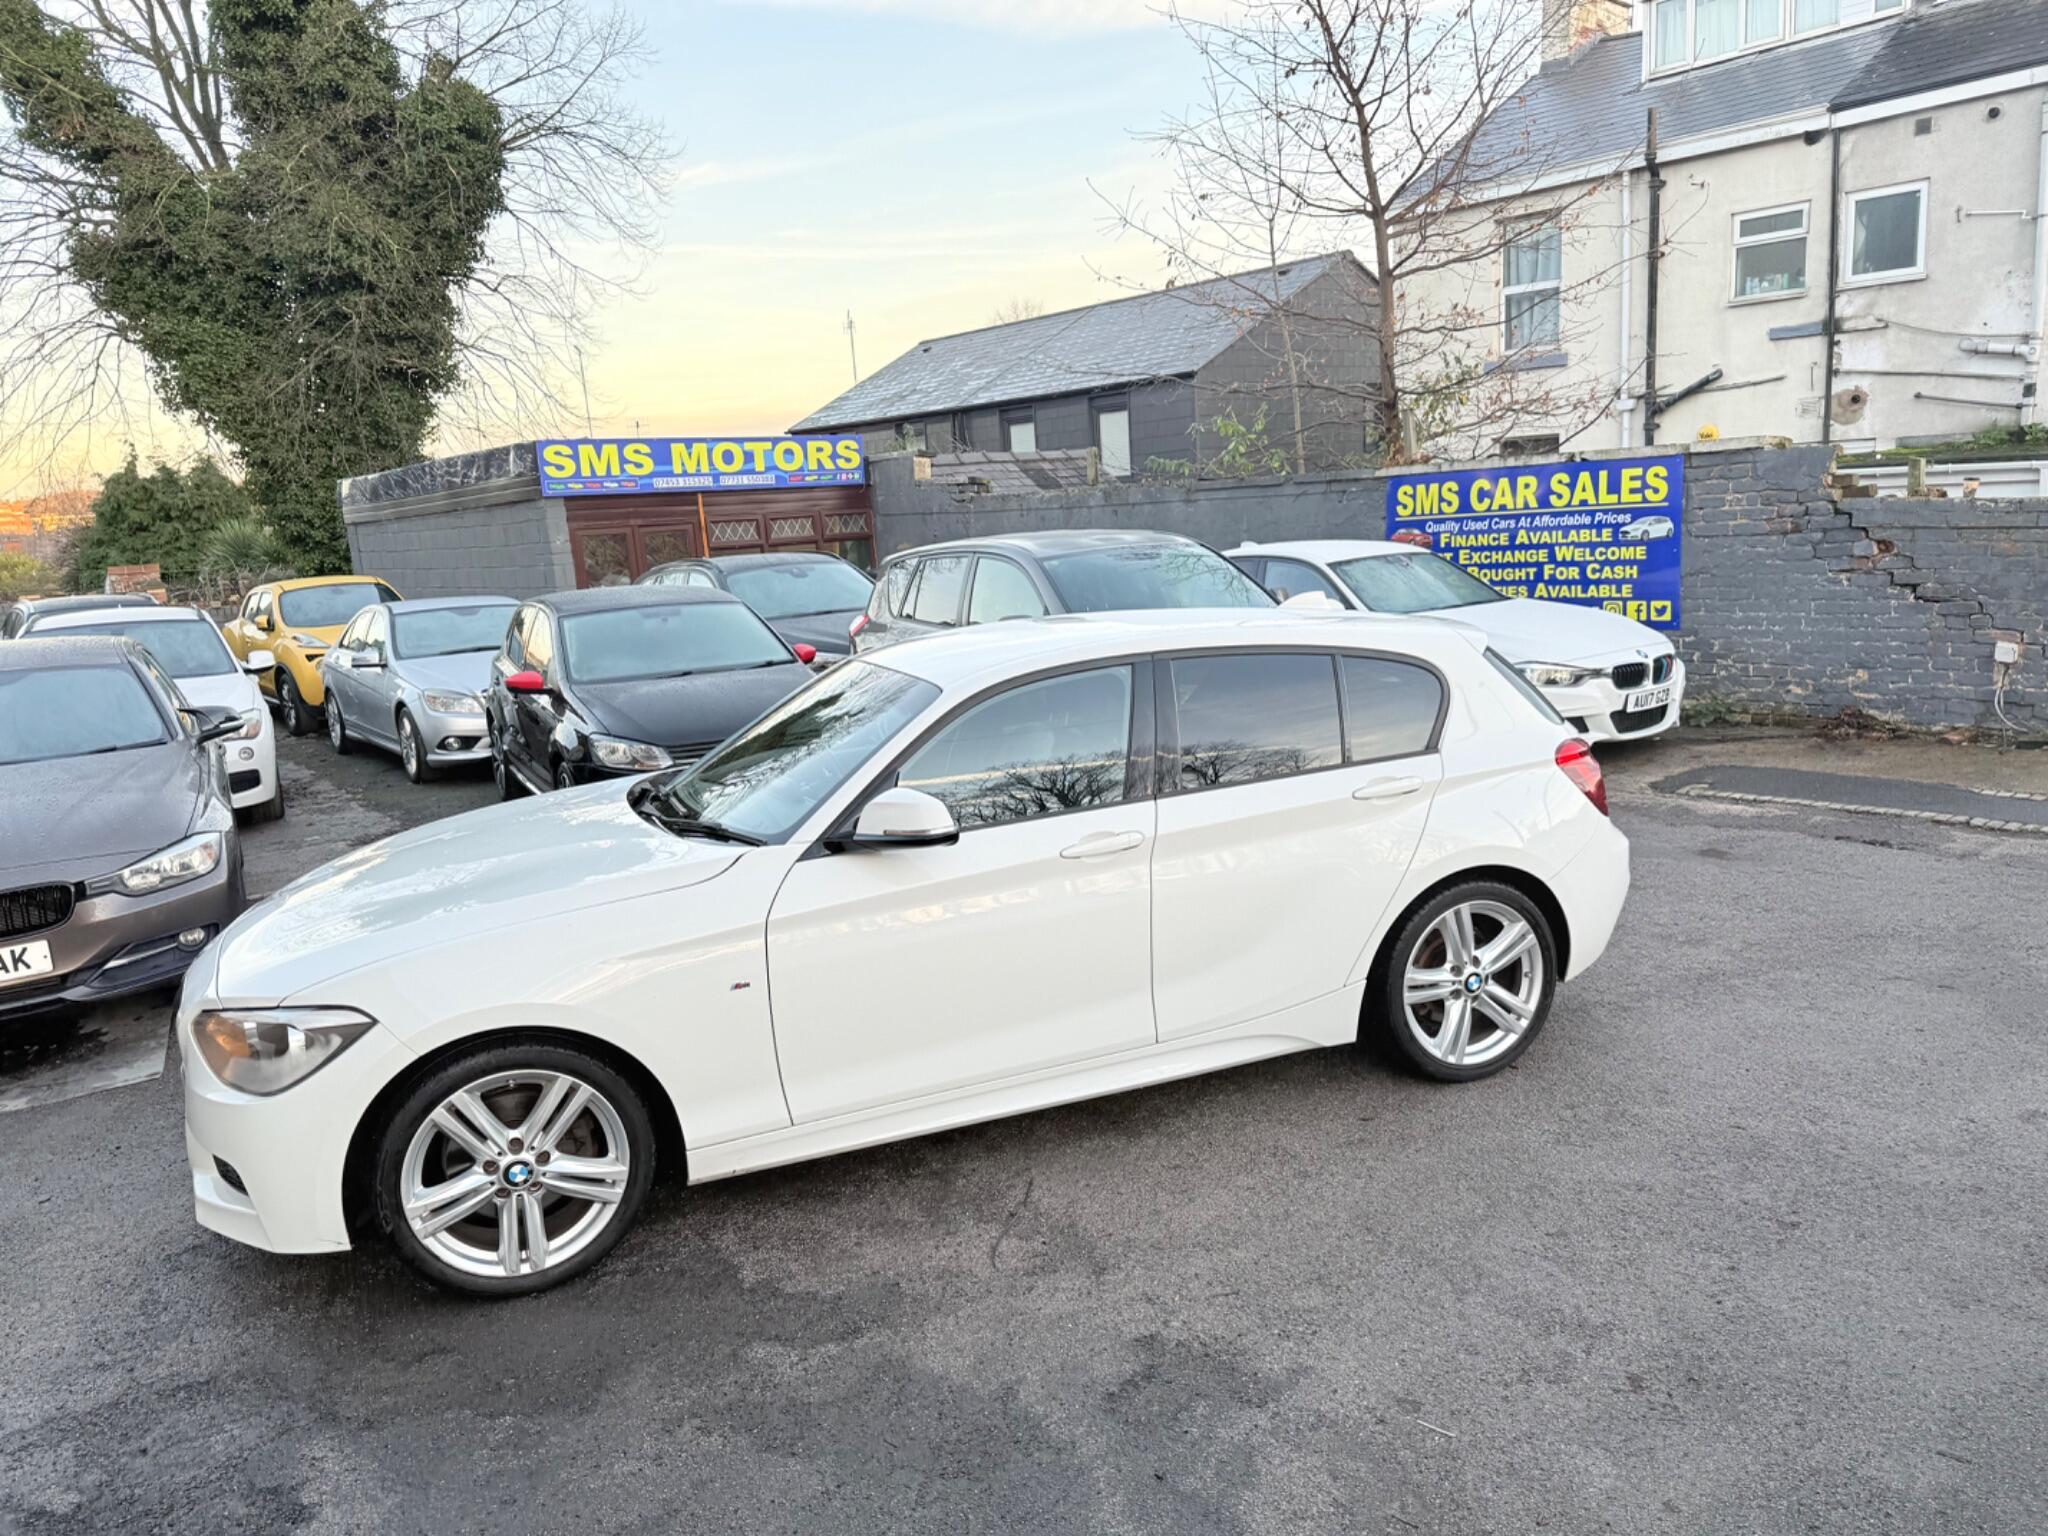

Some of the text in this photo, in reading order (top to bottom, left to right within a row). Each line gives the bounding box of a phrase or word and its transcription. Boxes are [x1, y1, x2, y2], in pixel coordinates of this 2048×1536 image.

[542, 440, 862, 478] SMS MOTORS
[1396, 465, 1669, 517] SMS CAR SALES
[1425, 511, 1632, 534] Quality Used Cars At Affordable Prices
[1440, 527, 1613, 548] FINANCE AVAILABLE
[1459, 547, 1548, 564] EXCHANGE
[1555, 545, 1647, 561] WELCOME
[1544, 564, 1580, 580] FOR
[1586, 563, 1638, 579] CASH
[1534, 583, 1633, 598] AVAILABLE
